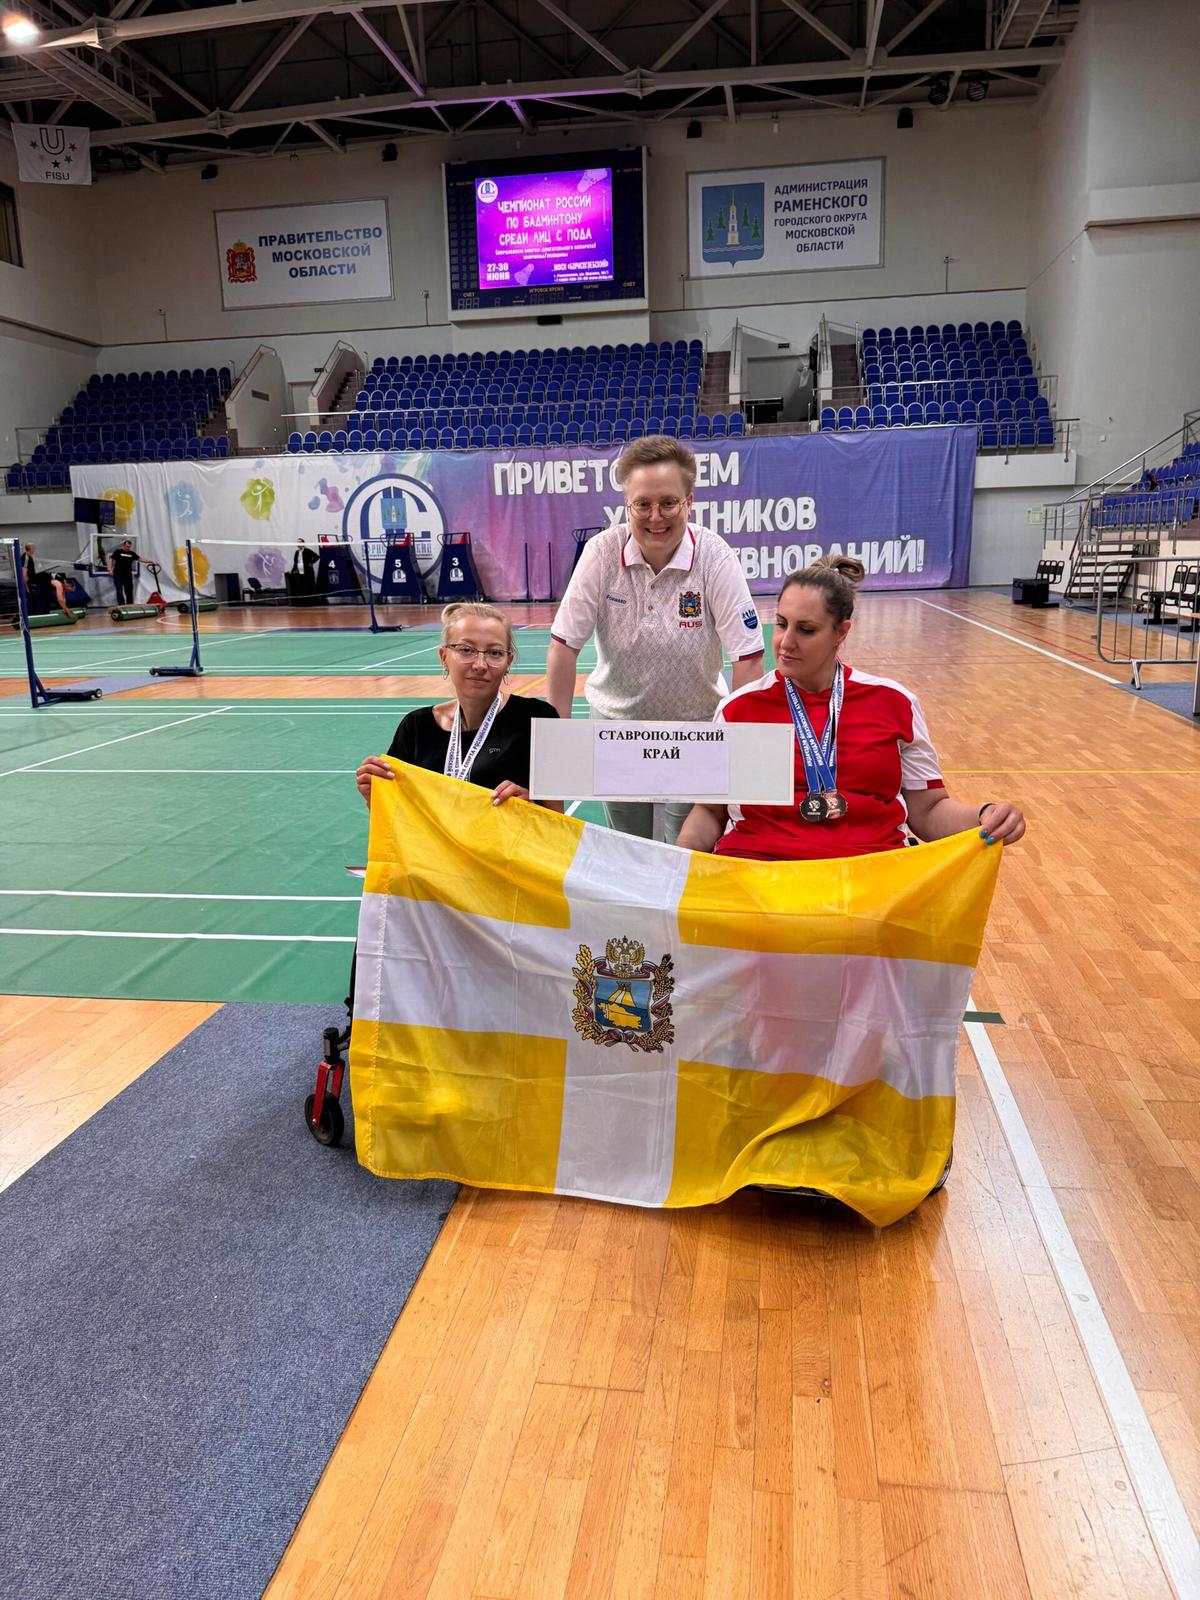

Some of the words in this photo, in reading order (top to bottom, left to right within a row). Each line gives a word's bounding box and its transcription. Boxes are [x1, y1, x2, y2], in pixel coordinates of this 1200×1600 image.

[45, 171, 70, 181] FISU
[774, 178, 868, 196] АДМИНИСТРАЦИЯ
[497, 197, 551, 214] ЧЕМПИОНАТ
[556, 194, 592, 209] РОССИИ
[774, 194, 868, 213] РАМЕНСКОГО
[506, 216, 519, 230] ПО
[523, 212, 583, 228] БАДМИНТОНУ
[774, 215, 832, 227] ГОРОДСКОГО
[833, 212, 867, 223] ОКРУГА
[258, 227, 383, 247] ПРАВИТЕЛЬСТВО
[499, 231, 529, 246] СРЕДИ
[533, 230, 552, 243] ЛИЦ
[556, 229, 563, 241] С
[567, 227, 592, 241] ПОДА
[785, 224, 855, 240] МОСКОВСКОЙ
[271, 243, 371, 263] МОСКОВСКОЙ
[796, 241, 844, 253] ОБЛАСТИ
[289, 262, 357, 278] ОБЛАСТИ
[487, 263, 509, 272] 27-30
[487, 271, 511, 281] ИЮНЯ
[328, 560, 336, 568] 4
[394, 559, 402, 568] 5
[452, 557, 460, 566] 3
[679, 620, 703, 628] RUS
[598, 729, 725, 742] СТАВРОПОЛЬСКИЙ
[643, 746, 681, 760] КРАЙ
